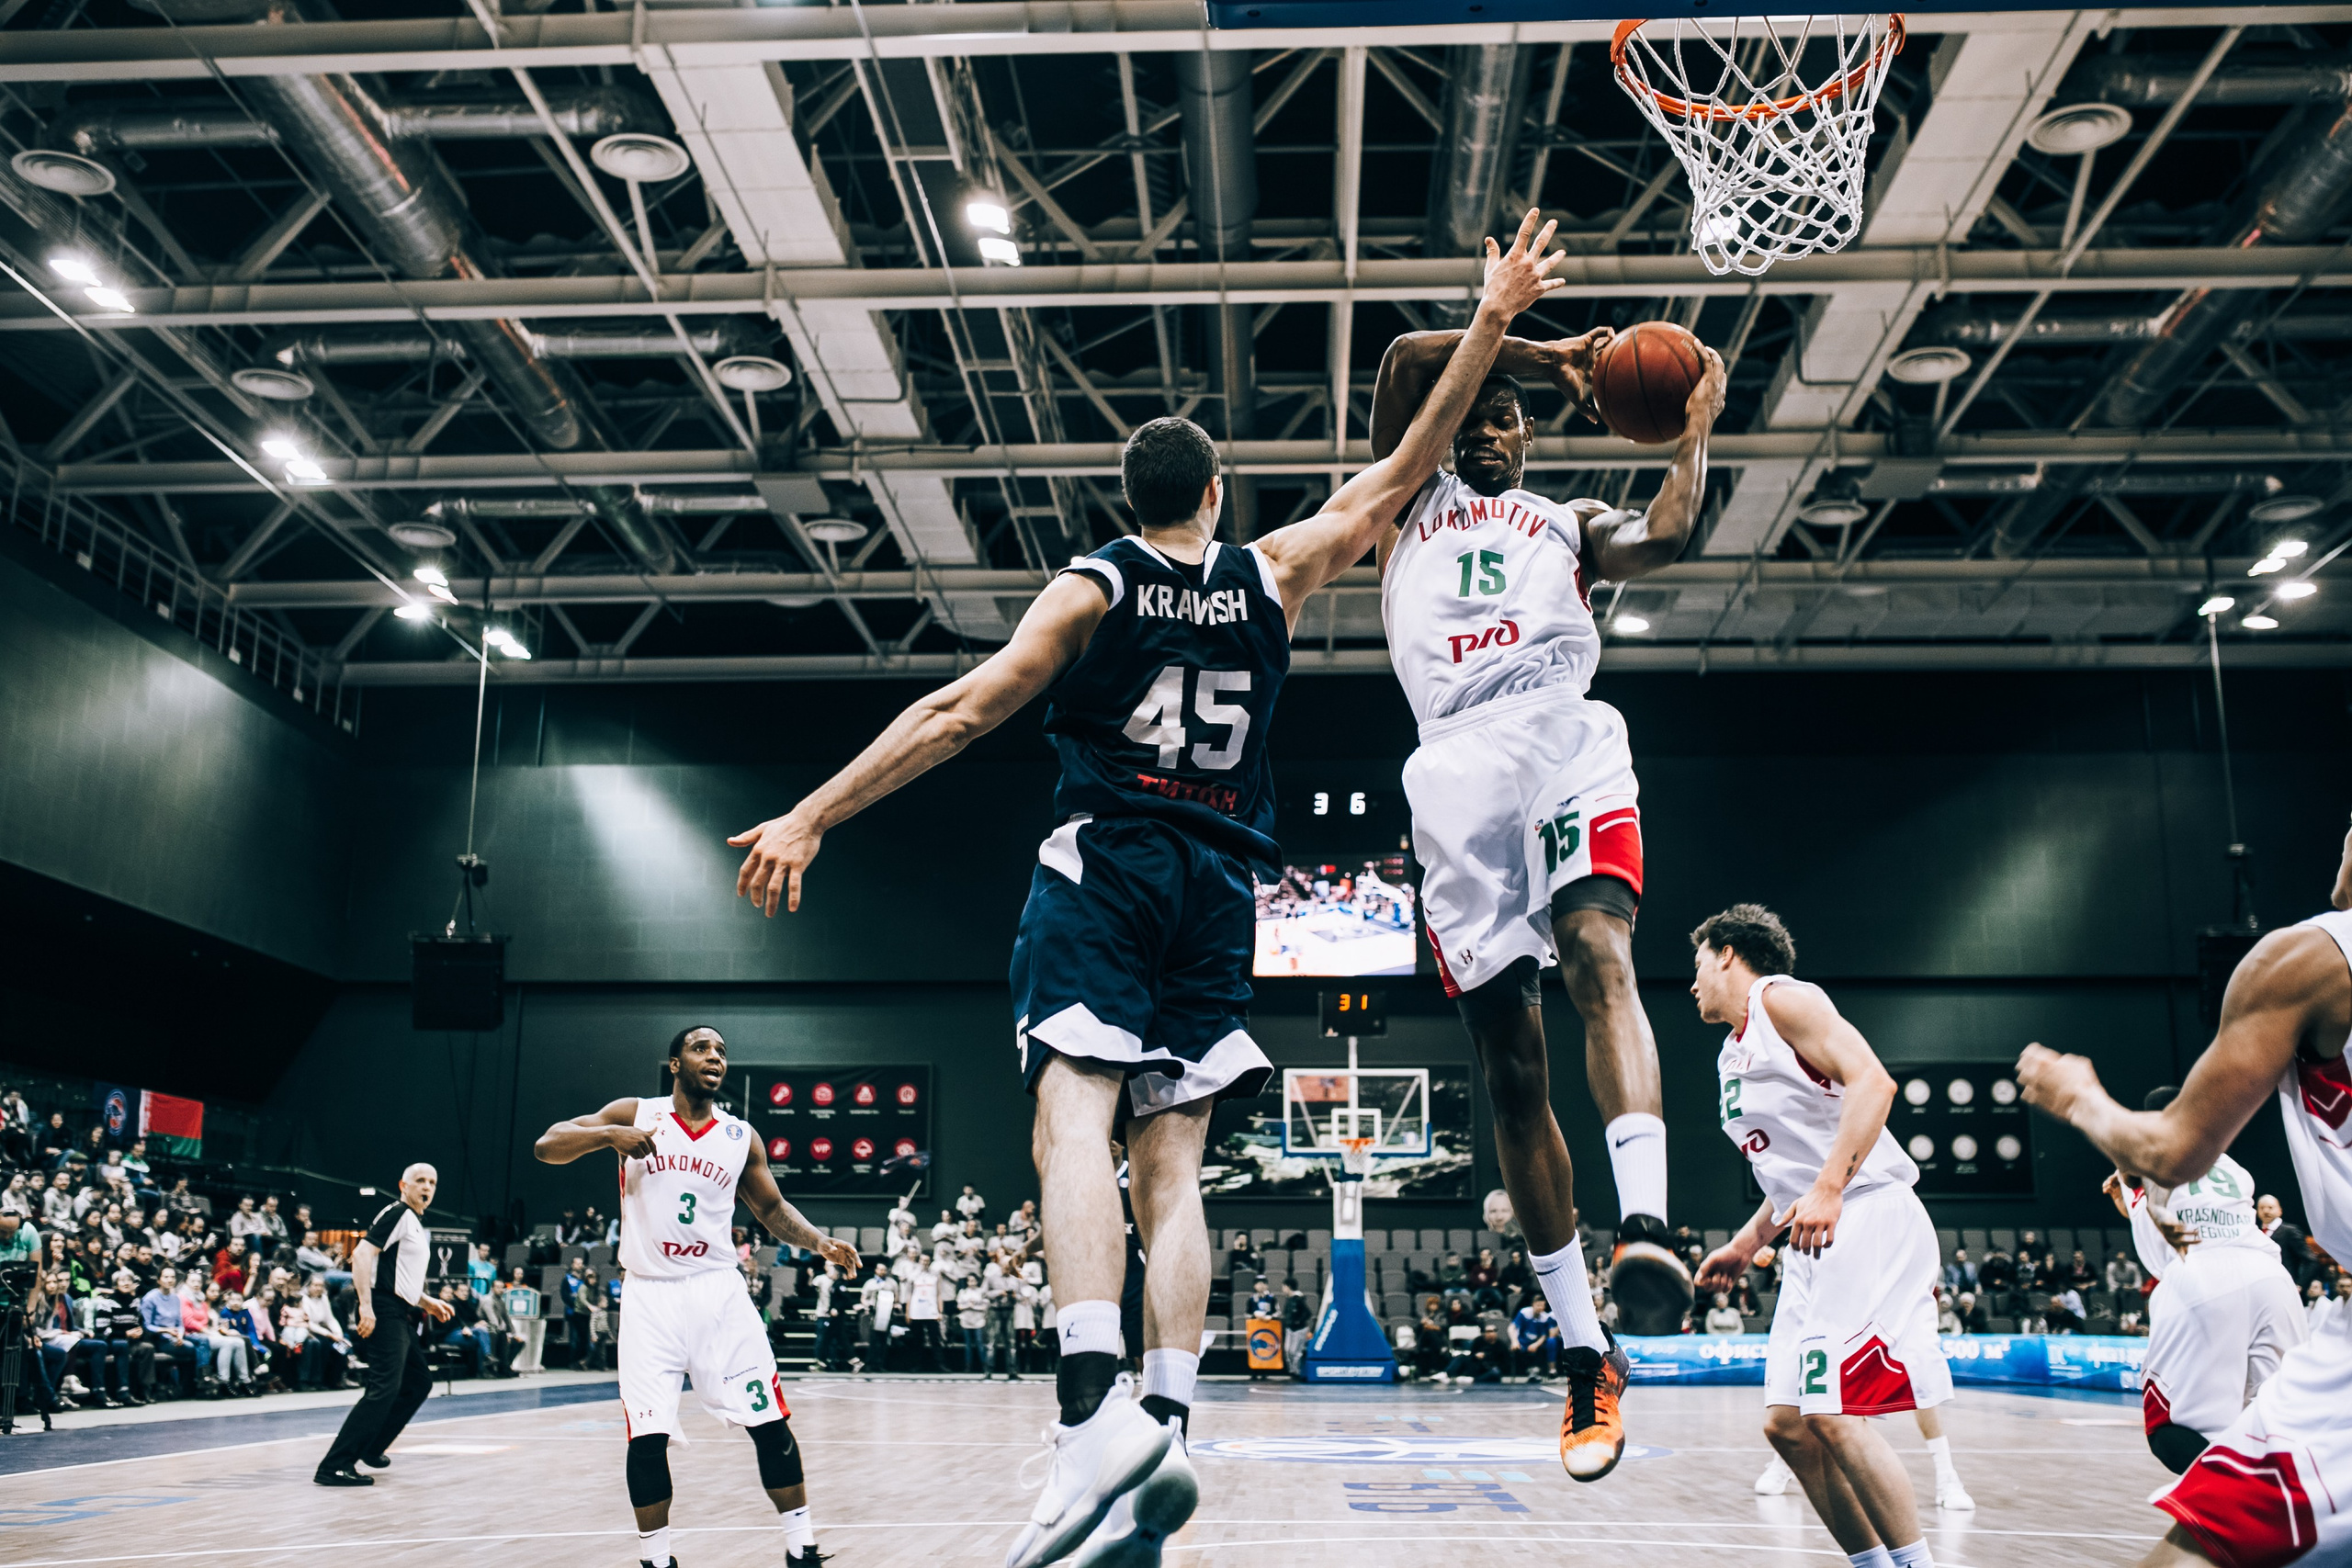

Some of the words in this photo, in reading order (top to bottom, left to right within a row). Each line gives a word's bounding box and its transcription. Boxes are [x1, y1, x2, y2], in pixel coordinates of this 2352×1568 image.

[1419, 499, 1547, 543] LOKOMOTIV
[1457, 549, 1507, 598] 15
[1122, 666, 1251, 770] 45
[1538, 810, 1580, 876] 15
[646, 1155, 732, 1190] LOKOMOTIV
[678, 1192, 697, 1225] 3
[746, 1379, 769, 1413] 3
